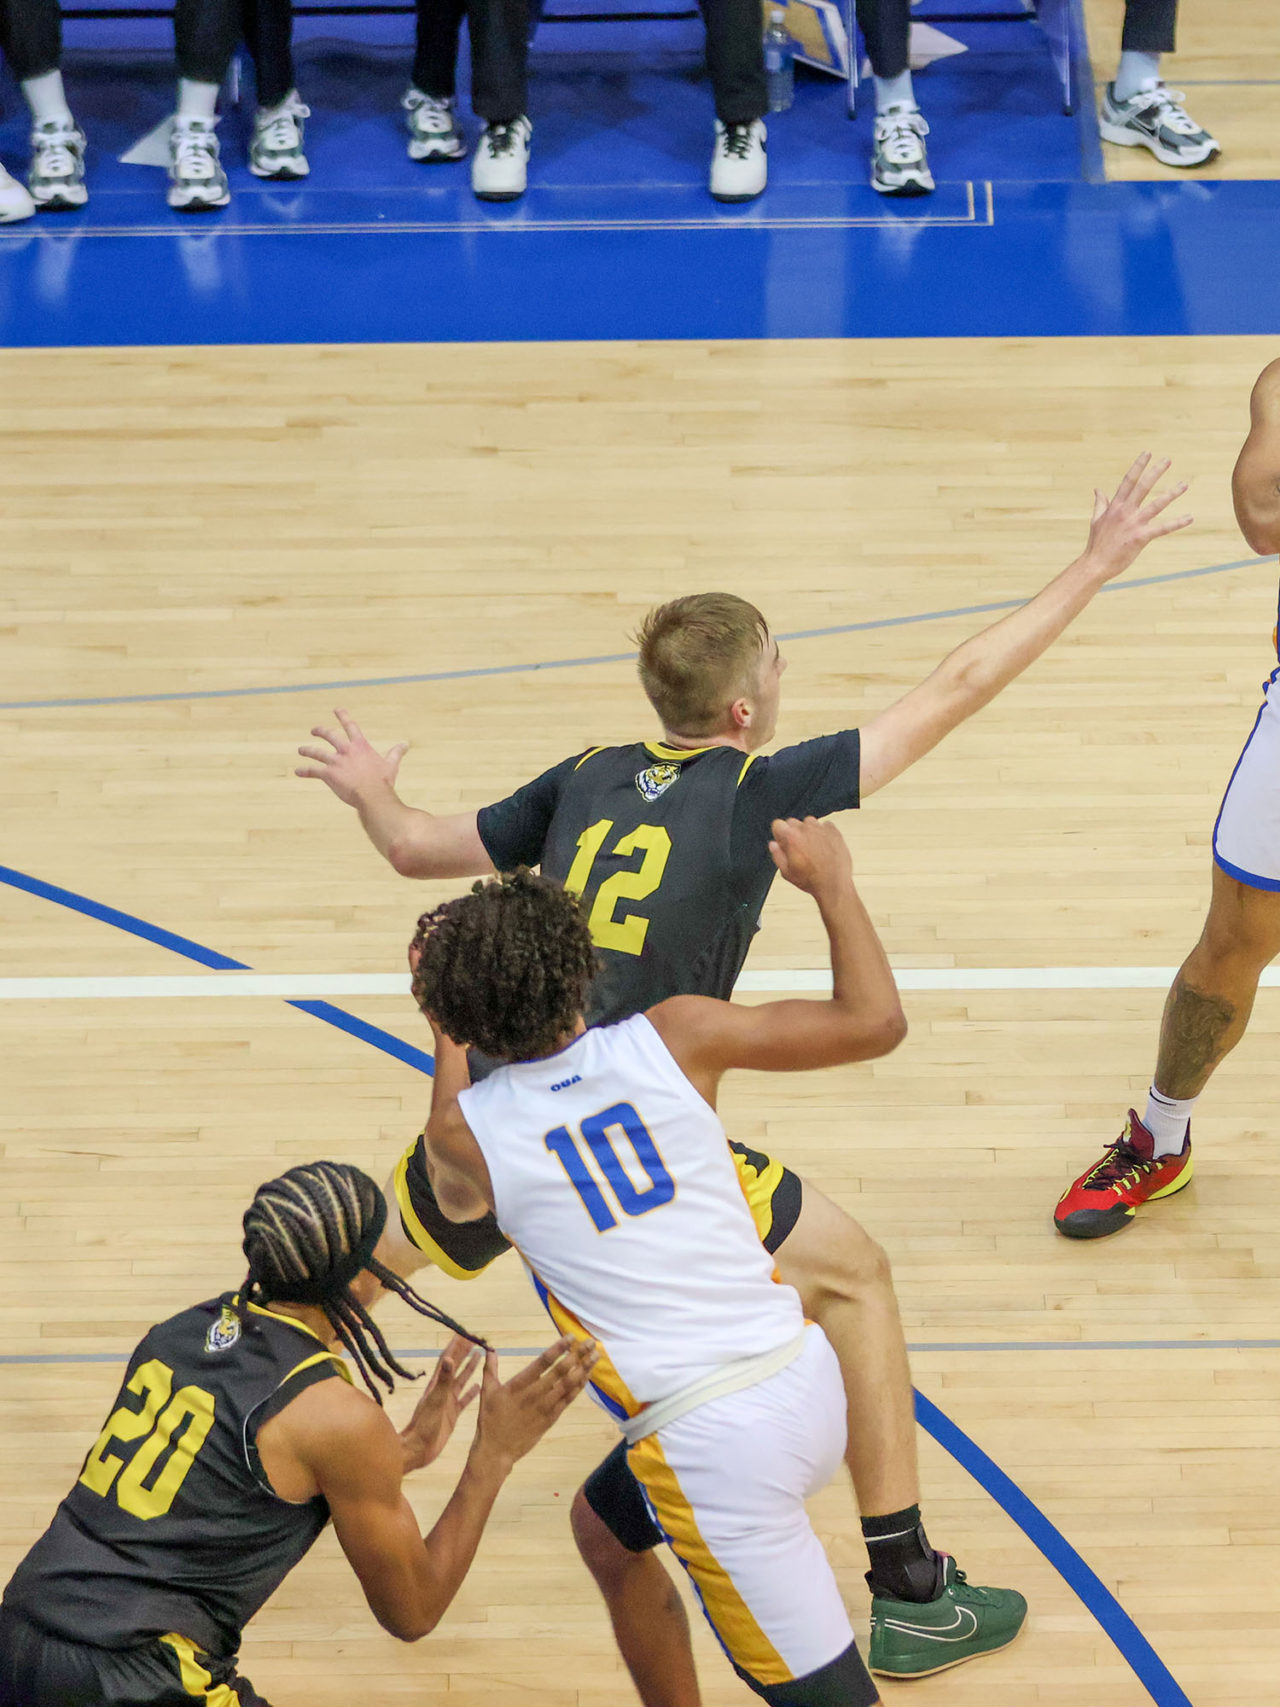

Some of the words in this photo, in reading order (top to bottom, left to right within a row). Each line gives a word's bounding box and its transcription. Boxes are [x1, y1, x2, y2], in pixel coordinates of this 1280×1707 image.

[563, 818, 673, 956] 12
[543, 1100, 677, 1235] 10
[79, 1358, 215, 1521] 20
